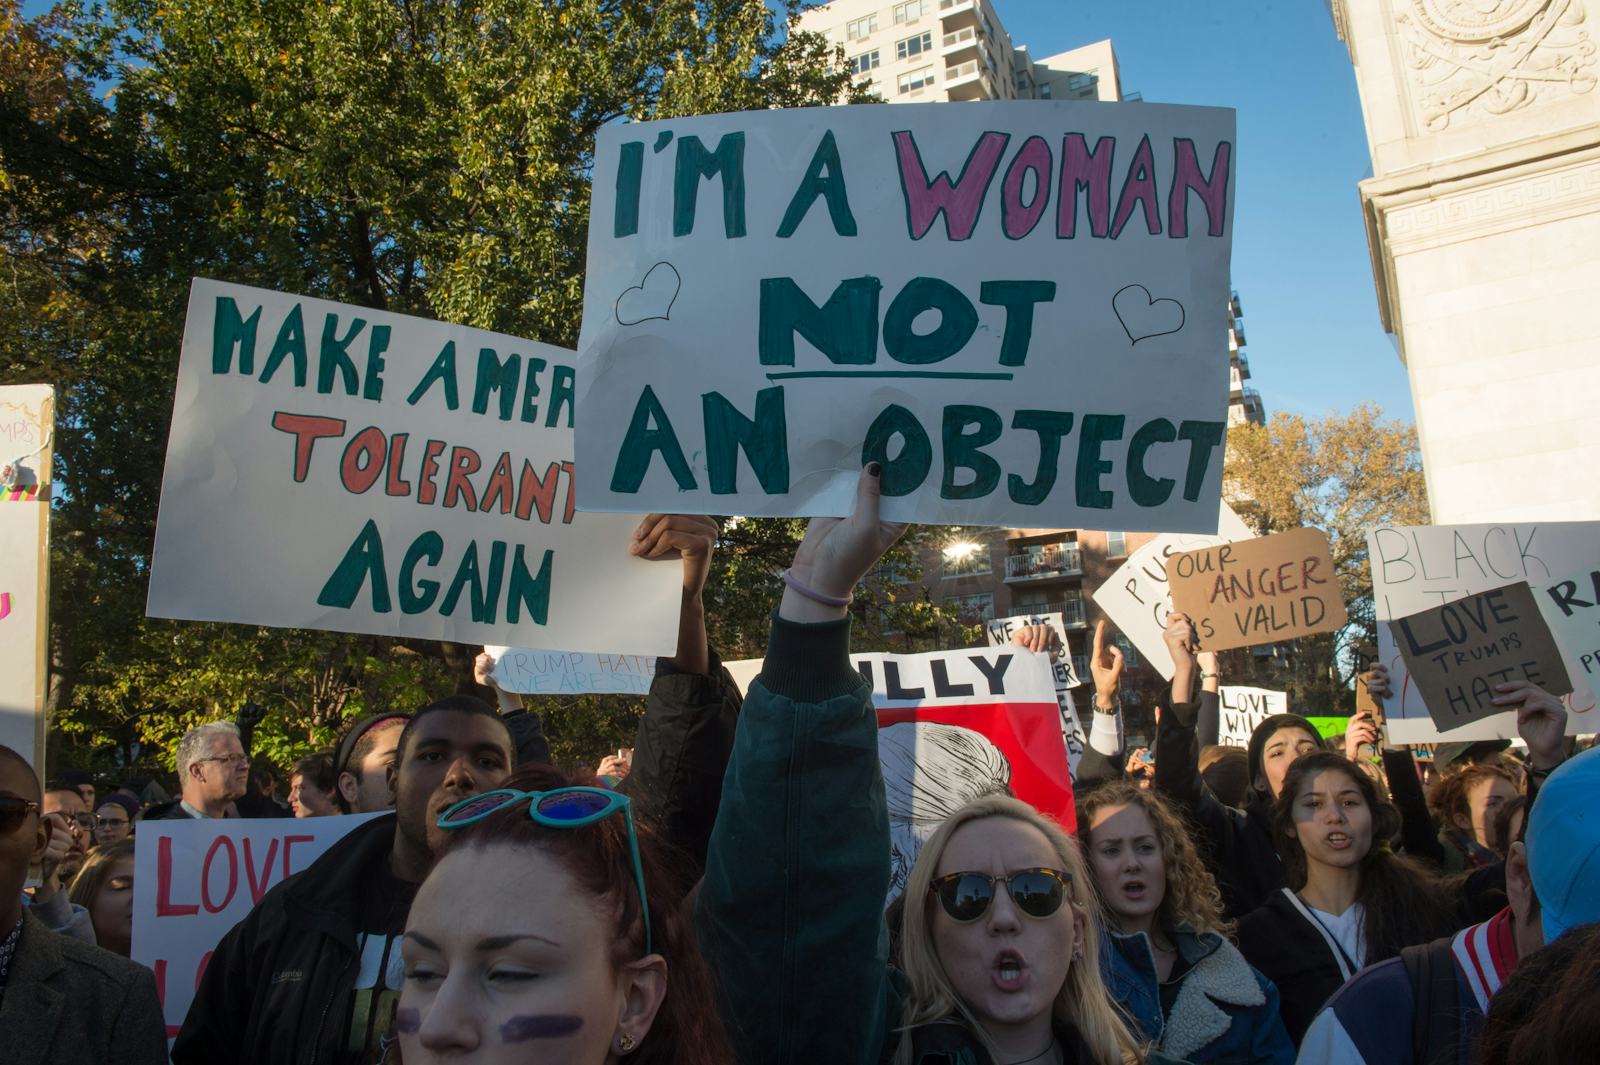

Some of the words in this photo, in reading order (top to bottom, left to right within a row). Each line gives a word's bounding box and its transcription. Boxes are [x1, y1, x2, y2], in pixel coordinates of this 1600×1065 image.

[613, 130, 747, 238] I'M
[776, 130, 857, 238] A
[891, 131, 1230, 240] WOMAN
[212, 296, 391, 403] MAKE
[759, 276, 1056, 367] NOT
[610, 384, 789, 494] AN
[862, 402, 1225, 509] OBJECT
[317, 518, 554, 626] AGAIN
[1177, 545, 1237, 578] OUR
[1209, 556, 1327, 604] ANGER
[1375, 527, 1550, 584] BLACK
[1235, 596, 1325, 637] VALID
[1400, 591, 1518, 657] LOVE
[502, 652, 584, 675] TRUMP
[1432, 632, 1522, 673] TRUMPS
[1220, 689, 1275, 715] LOVE
[1444, 661, 1545, 716] HATE
